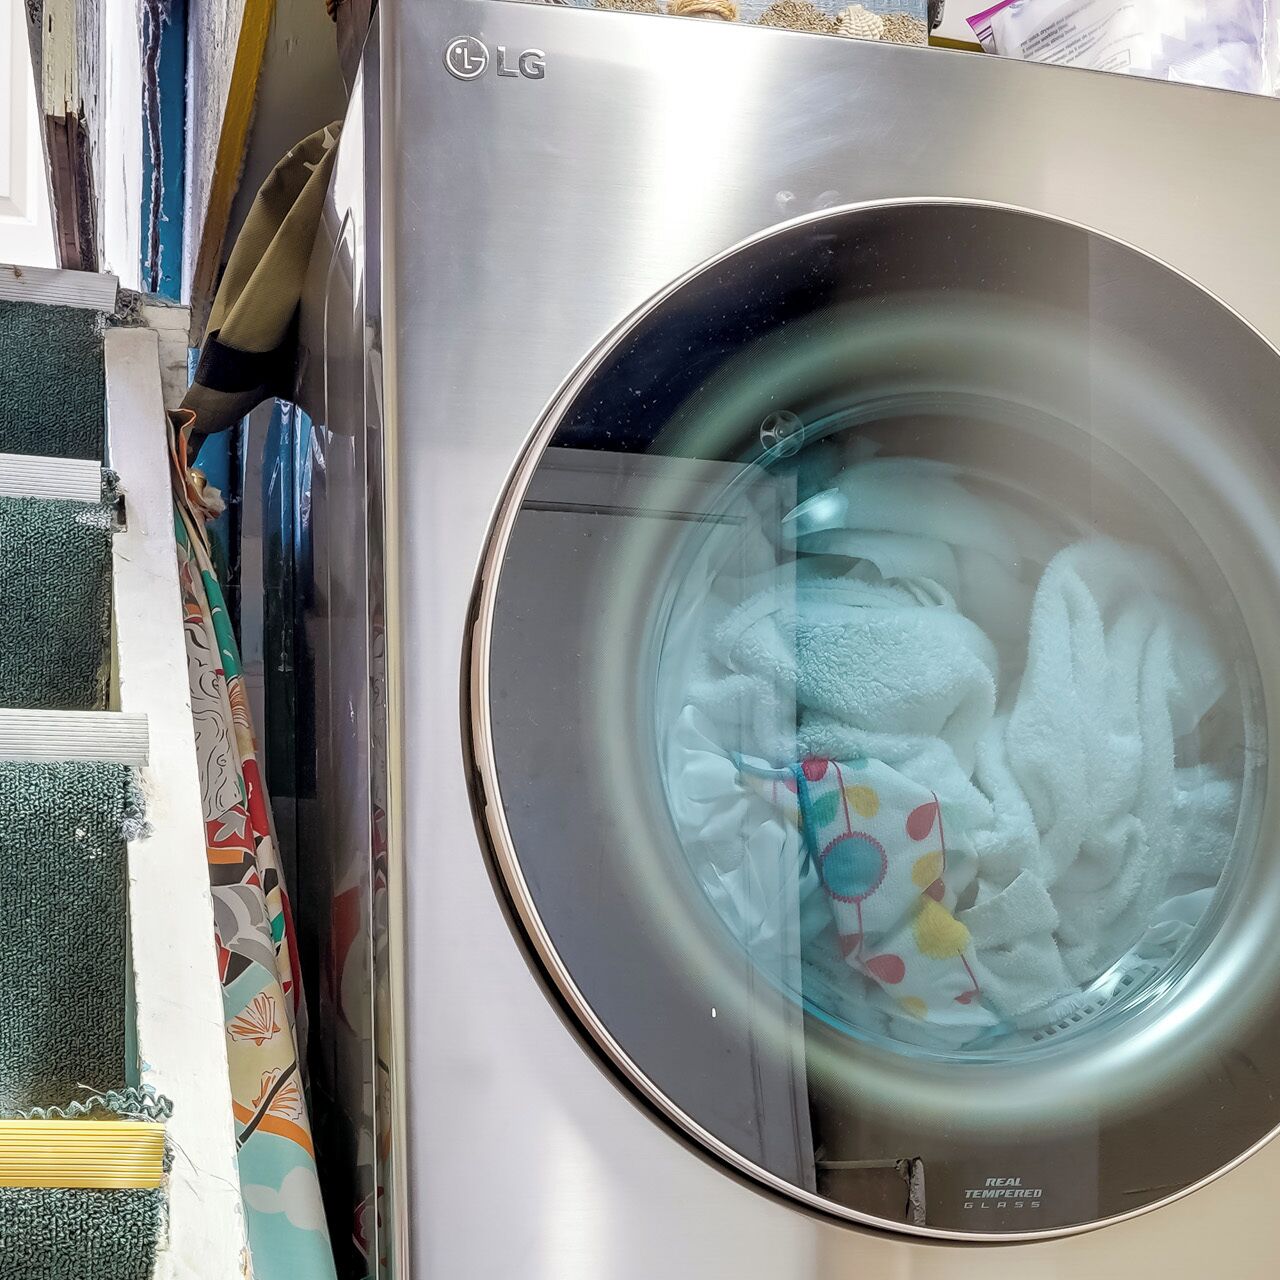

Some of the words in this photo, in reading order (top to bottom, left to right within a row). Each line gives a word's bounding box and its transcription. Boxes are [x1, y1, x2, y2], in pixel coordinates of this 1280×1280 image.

[496, 45, 546, 80] LG
[985, 1177, 1023, 1187] REAL
[964, 1189, 1043, 1199] TEMPERED
[963, 1201, 1041, 1209] GLASS
